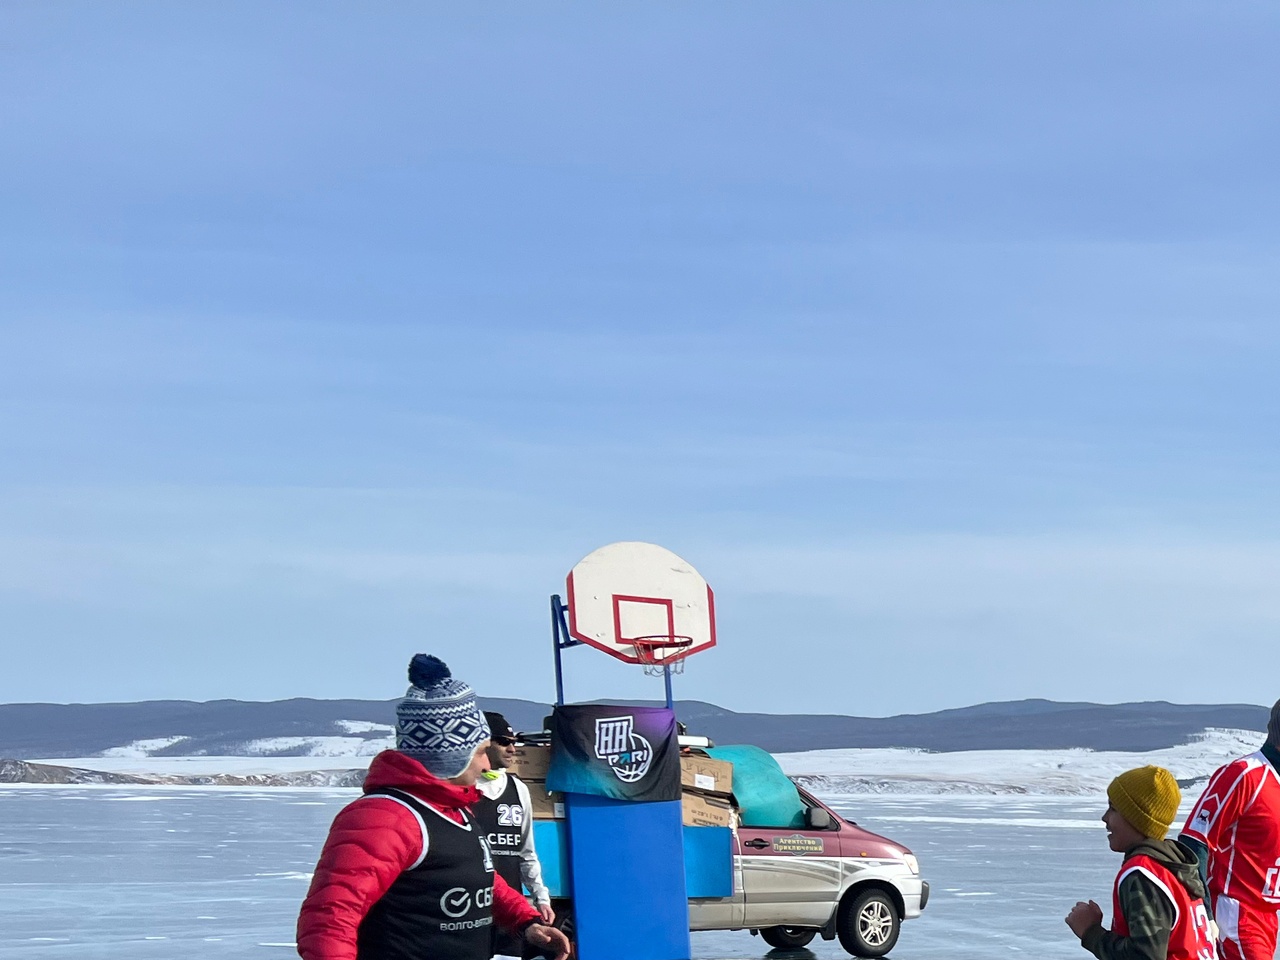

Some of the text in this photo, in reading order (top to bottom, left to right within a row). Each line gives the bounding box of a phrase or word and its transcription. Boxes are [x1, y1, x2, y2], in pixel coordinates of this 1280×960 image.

[608, 750, 648, 766] PARI
[497, 804, 522, 826] 26
[487, 833, 521, 846] СБЕР
